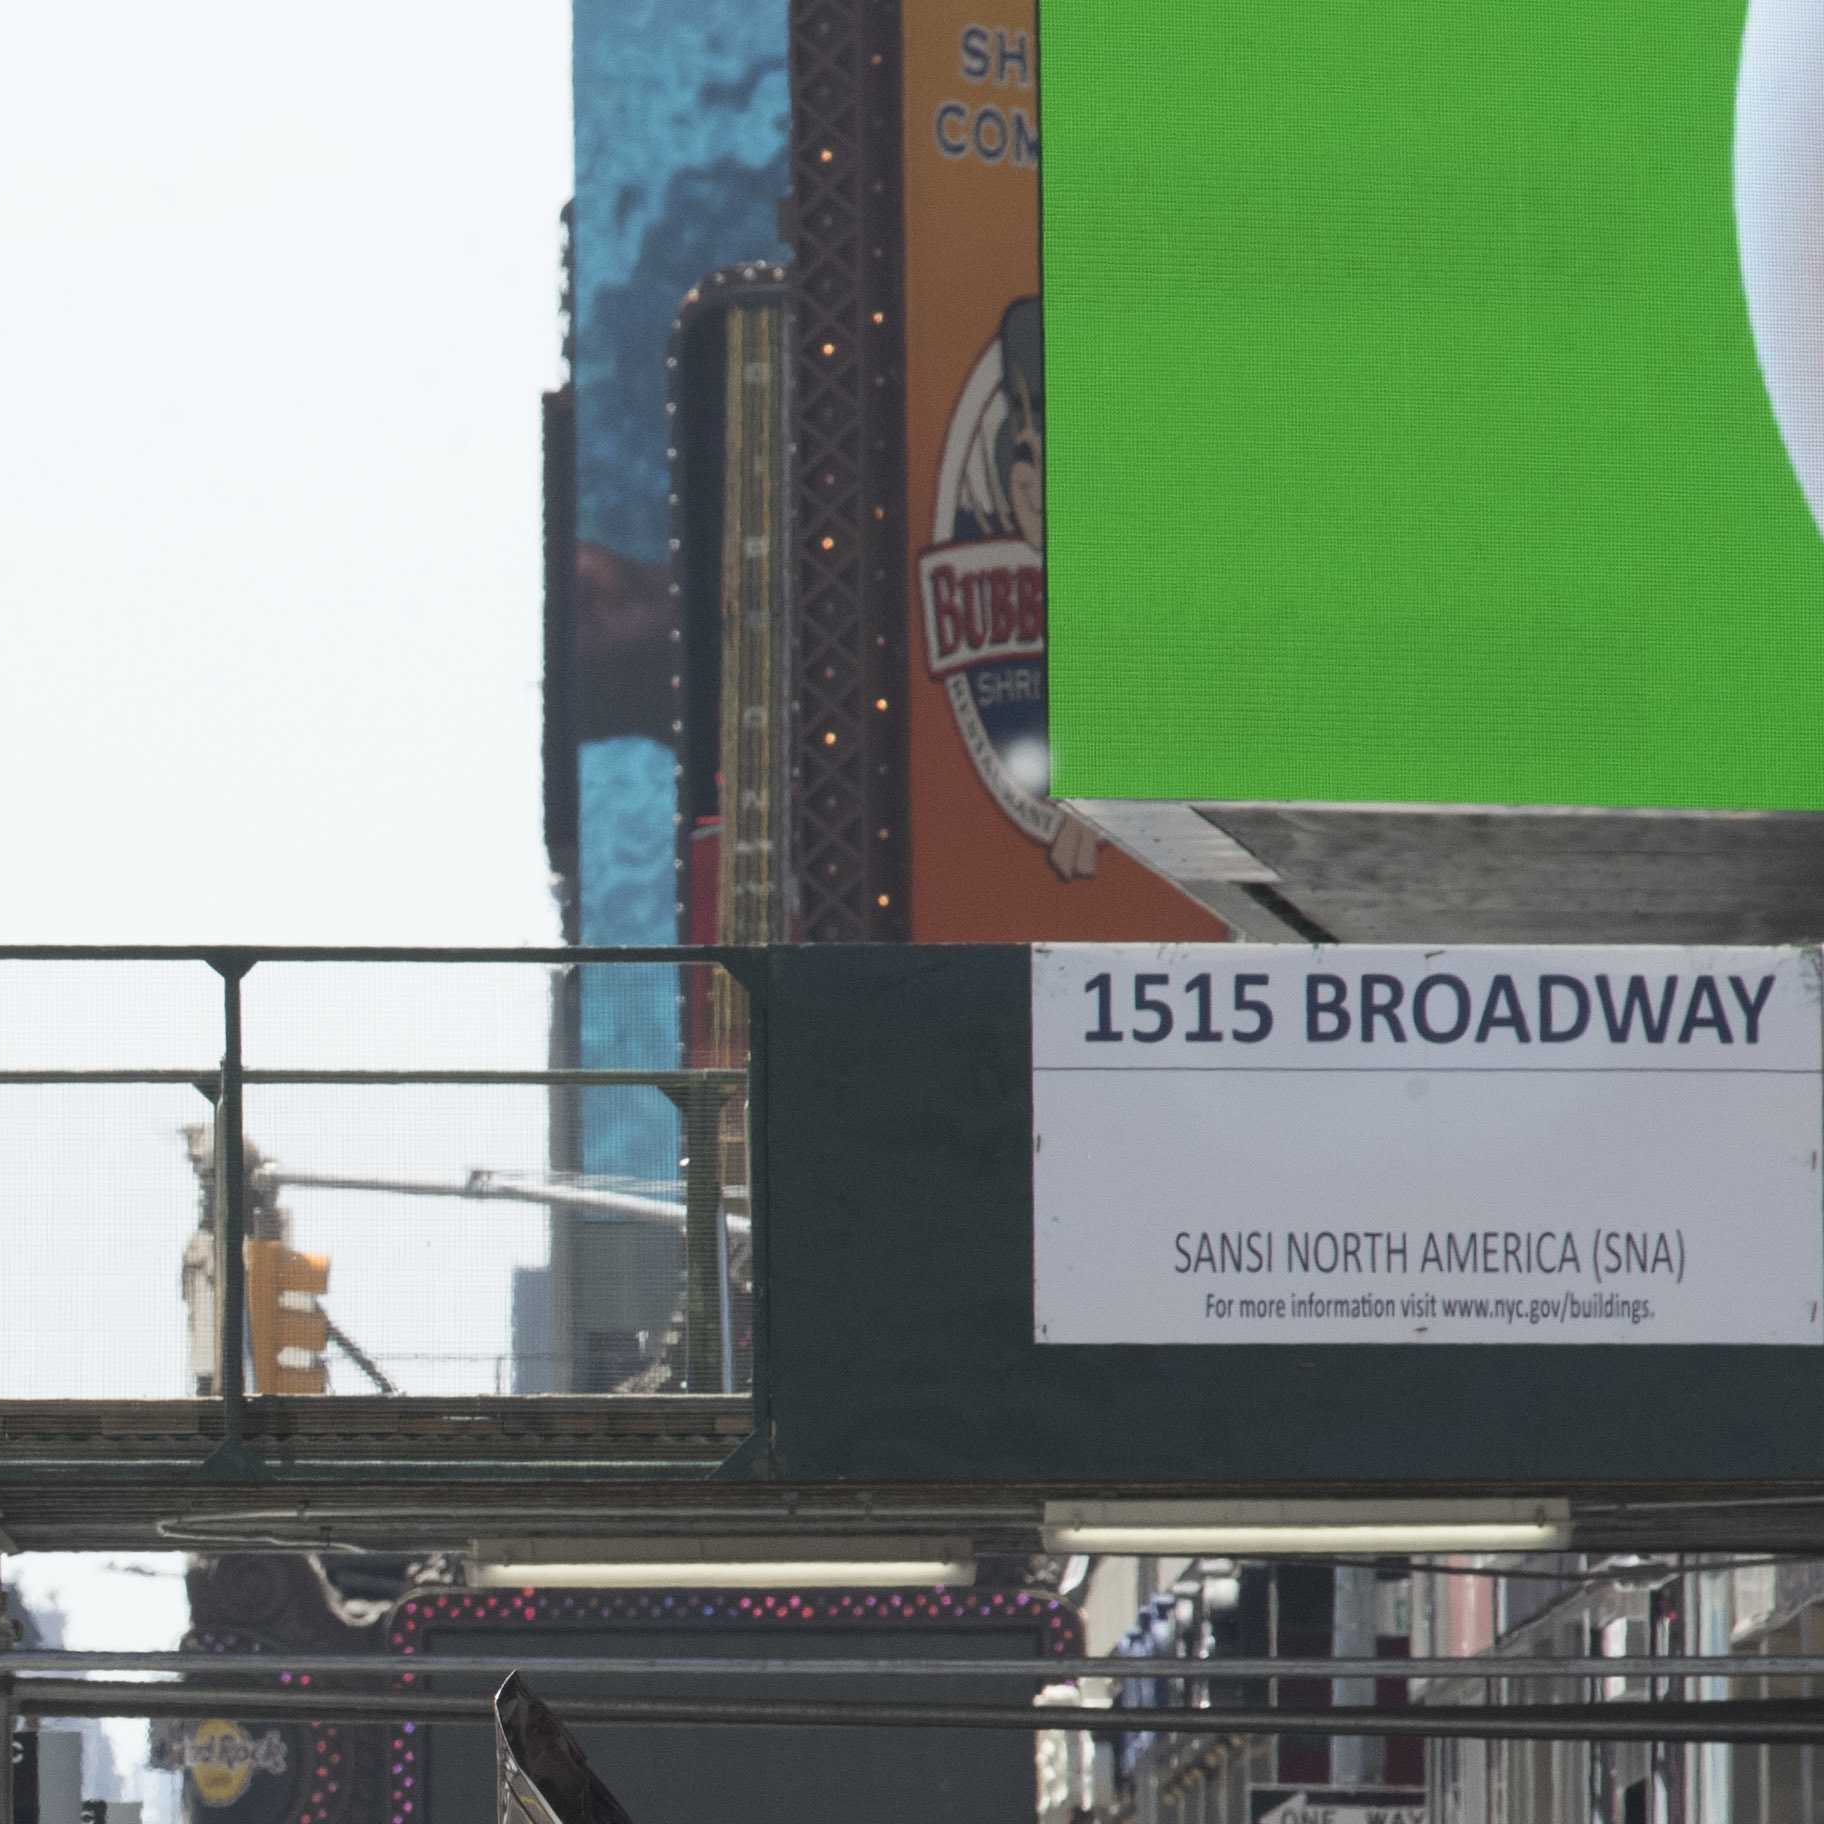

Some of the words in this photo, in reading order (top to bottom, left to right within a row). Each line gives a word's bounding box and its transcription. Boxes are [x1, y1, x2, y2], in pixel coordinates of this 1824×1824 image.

[1083, 973, 1274, 1043] 1515
[1306, 973, 1775, 1045] BROADWAY
[1174, 1231, 1272, 1274] SANSI
[1287, 1231, 1407, 1273] NORTH
[1420, 1231, 1580, 1274] AMERICA
[1591, 1228, 1686, 1284] (SNA)
[1205, 1294, 1234, 1318] For
[1241, 1299, 1285, 1318] more
[1291, 1292, 1395, 1319] information
[1400, 1292, 1437, 1319] visit
